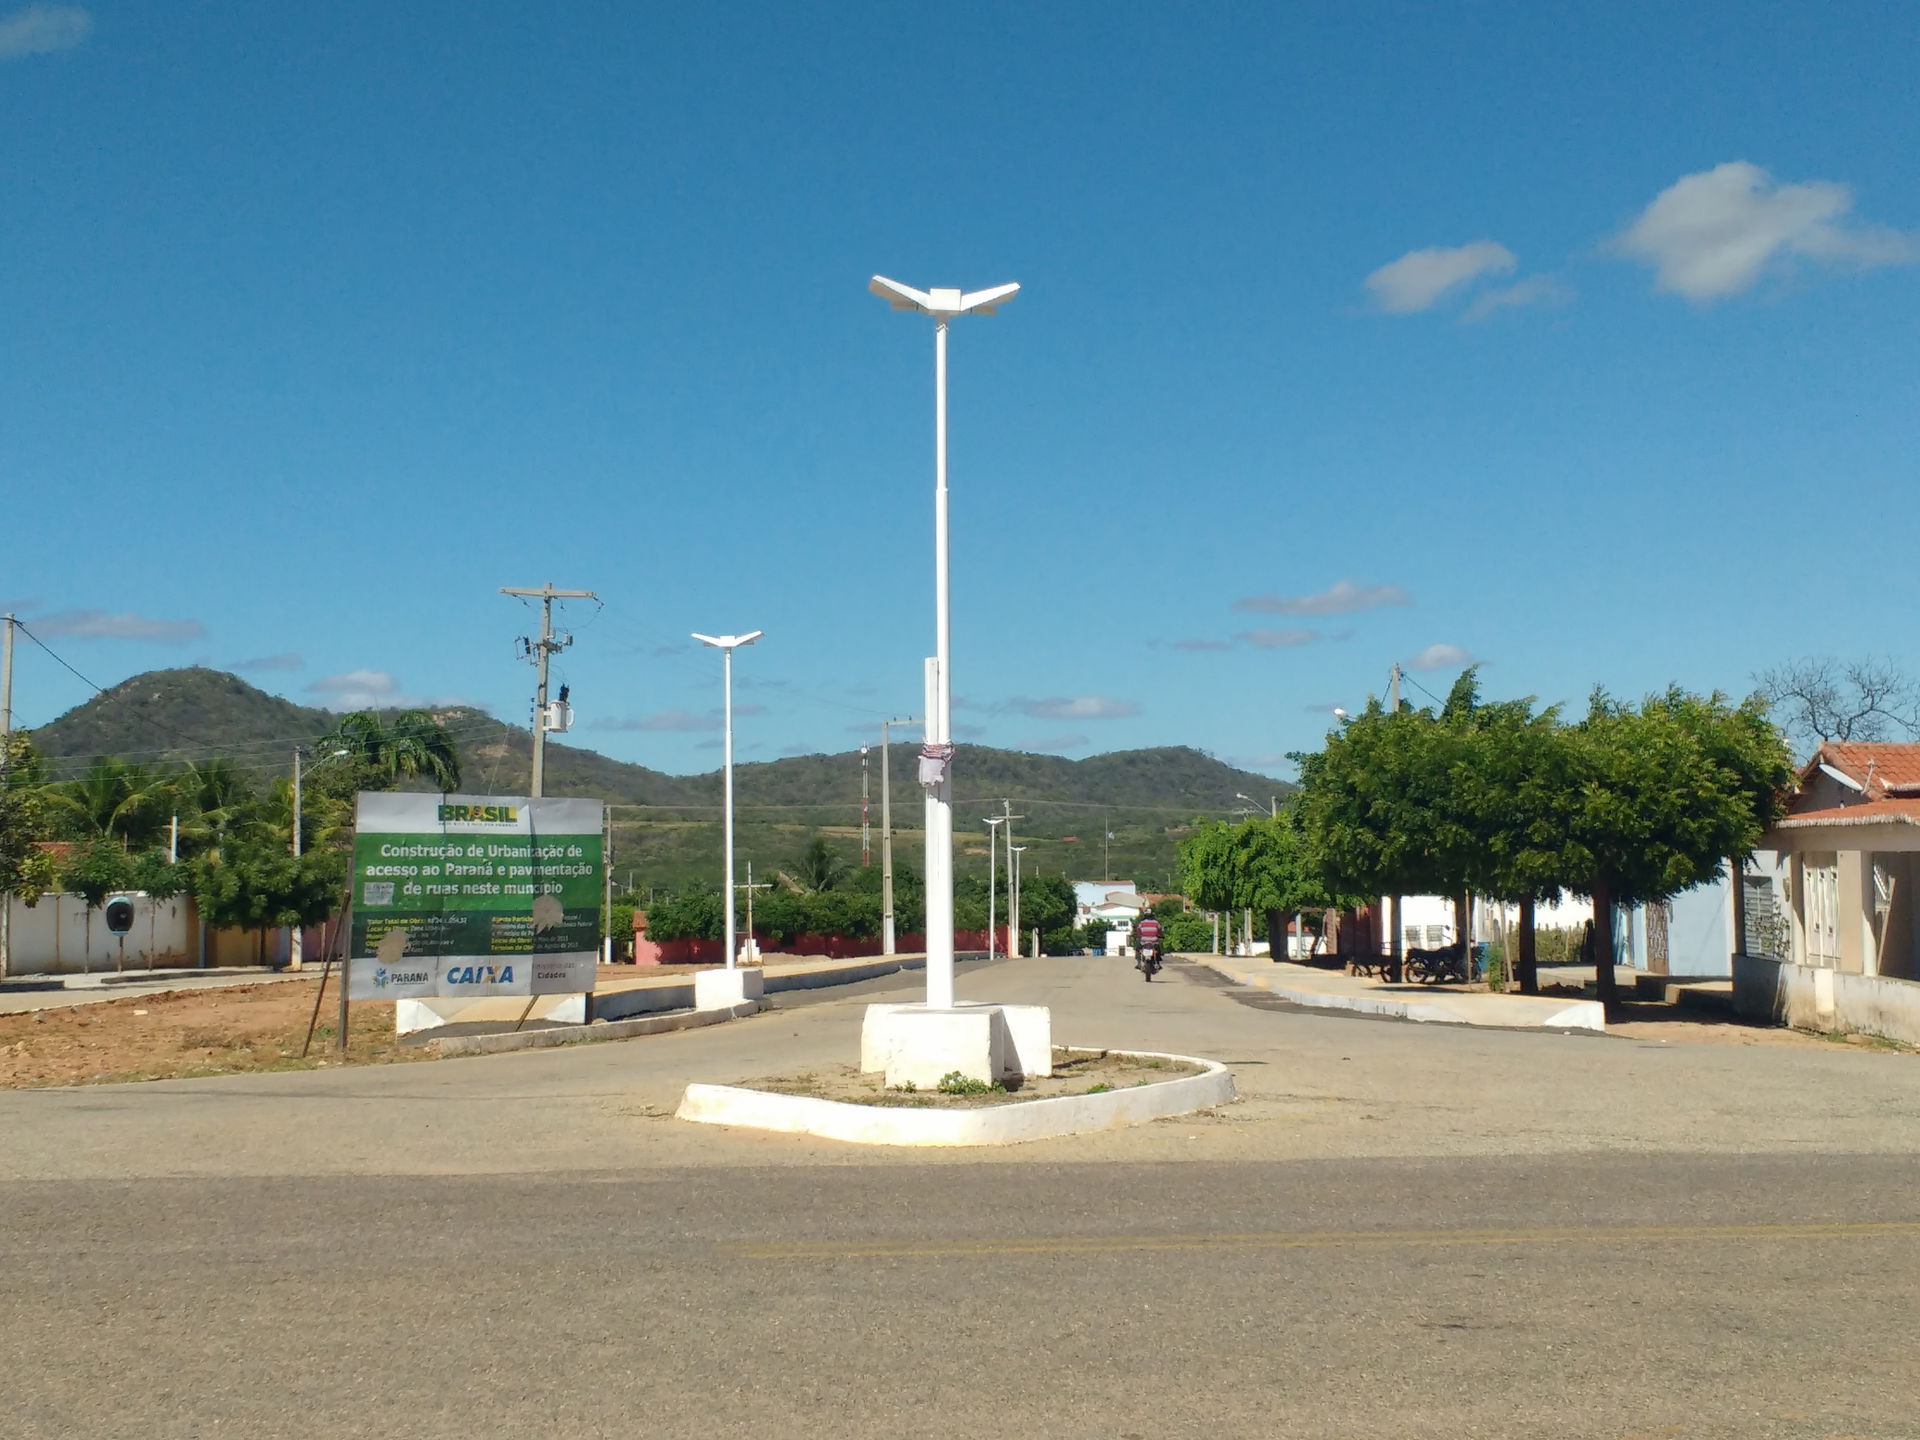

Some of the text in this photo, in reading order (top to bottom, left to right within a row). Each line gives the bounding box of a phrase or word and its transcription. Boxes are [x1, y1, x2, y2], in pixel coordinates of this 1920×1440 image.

[438, 805, 517, 822] BRASIL
[381, 844, 463, 860] Construção
[467, 844, 484, 857] de
[567, 845, 583, 857] de
[366, 865, 418, 876] acesso
[422, 865, 440, 876] ao
[445, 862, 493, 876] Paraná
[497, 865, 506, 876] e
[403, 881, 422, 895] de
[426, 883, 459, 895] ruas
[463, 882, 501, 895] neste
[447, 965, 514, 984] CAIXA
[537, 971, 566, 979] Cidades
